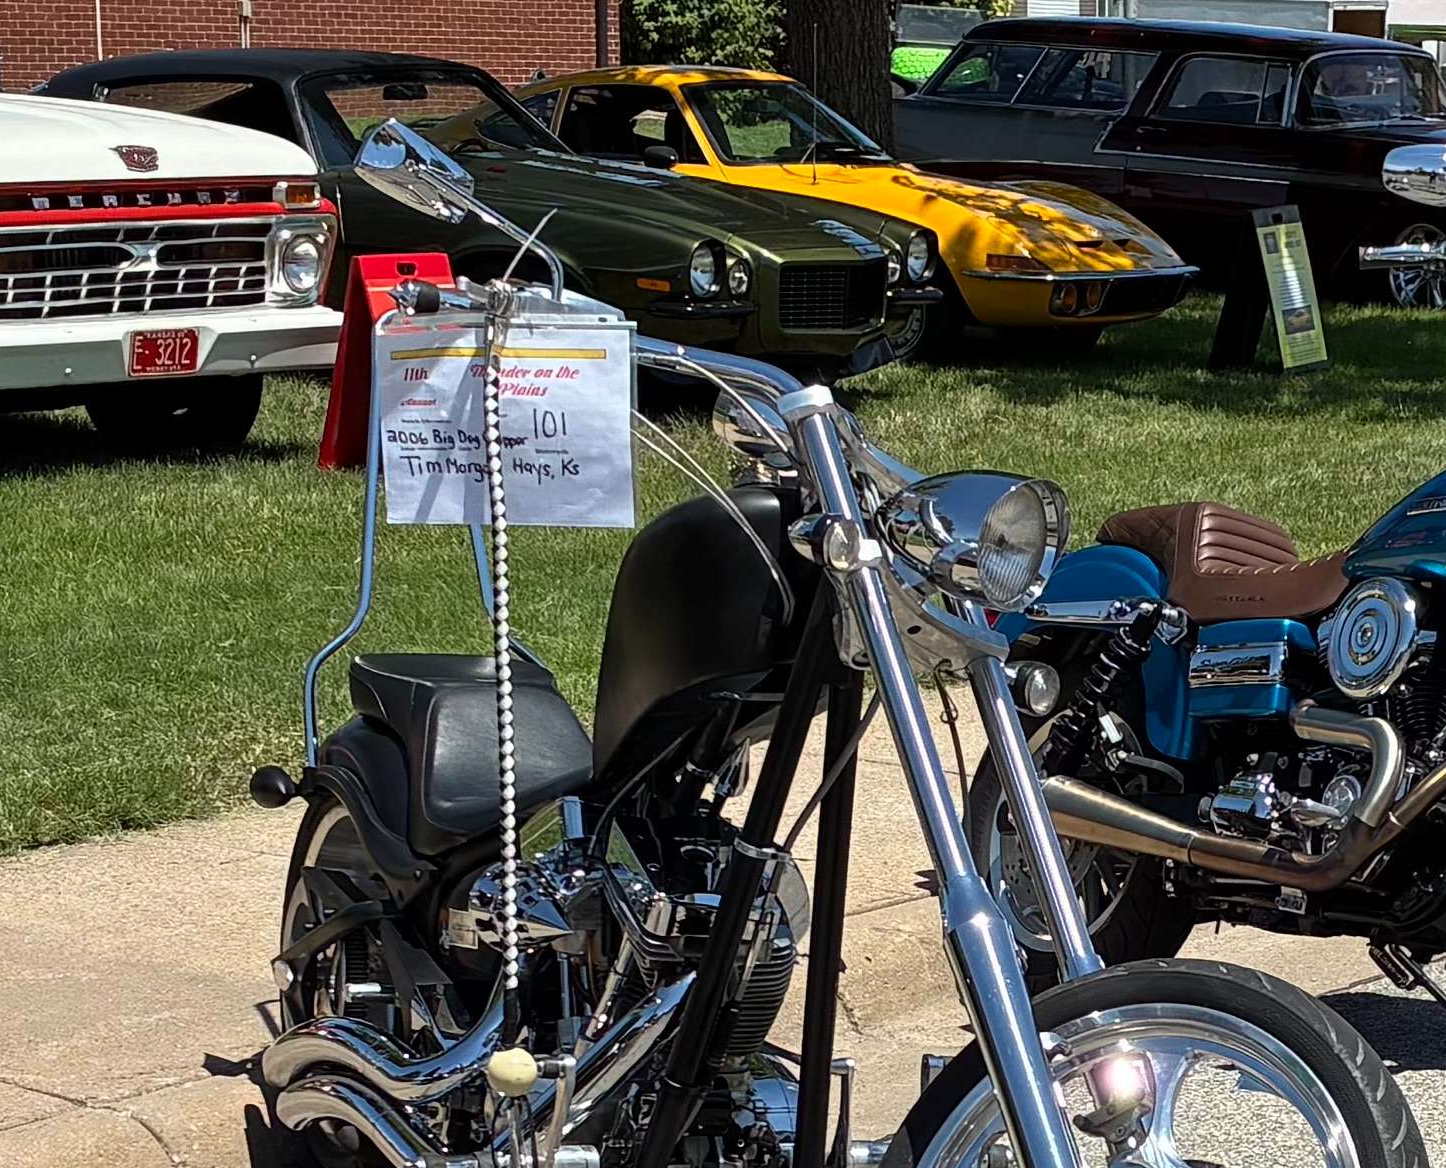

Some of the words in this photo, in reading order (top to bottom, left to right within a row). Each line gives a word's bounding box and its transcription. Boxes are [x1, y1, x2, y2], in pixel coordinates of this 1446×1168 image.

[155, 339, 191, 365] 3212
[404, 367, 429, 382] 11th
[470, 364, 531, 379] Thnder
[534, 370, 552, 379] on
[555, 366, 580, 380] the
[498, 383, 549, 397] Plains
[533, 408, 568, 440] 101
[386, 429, 429, 446] 2006
[432, 429, 456, 450] Big
[399, 455, 444, 477] Tim
[446, 457, 493, 484] Morga
[512, 457, 555, 486] Hays,
